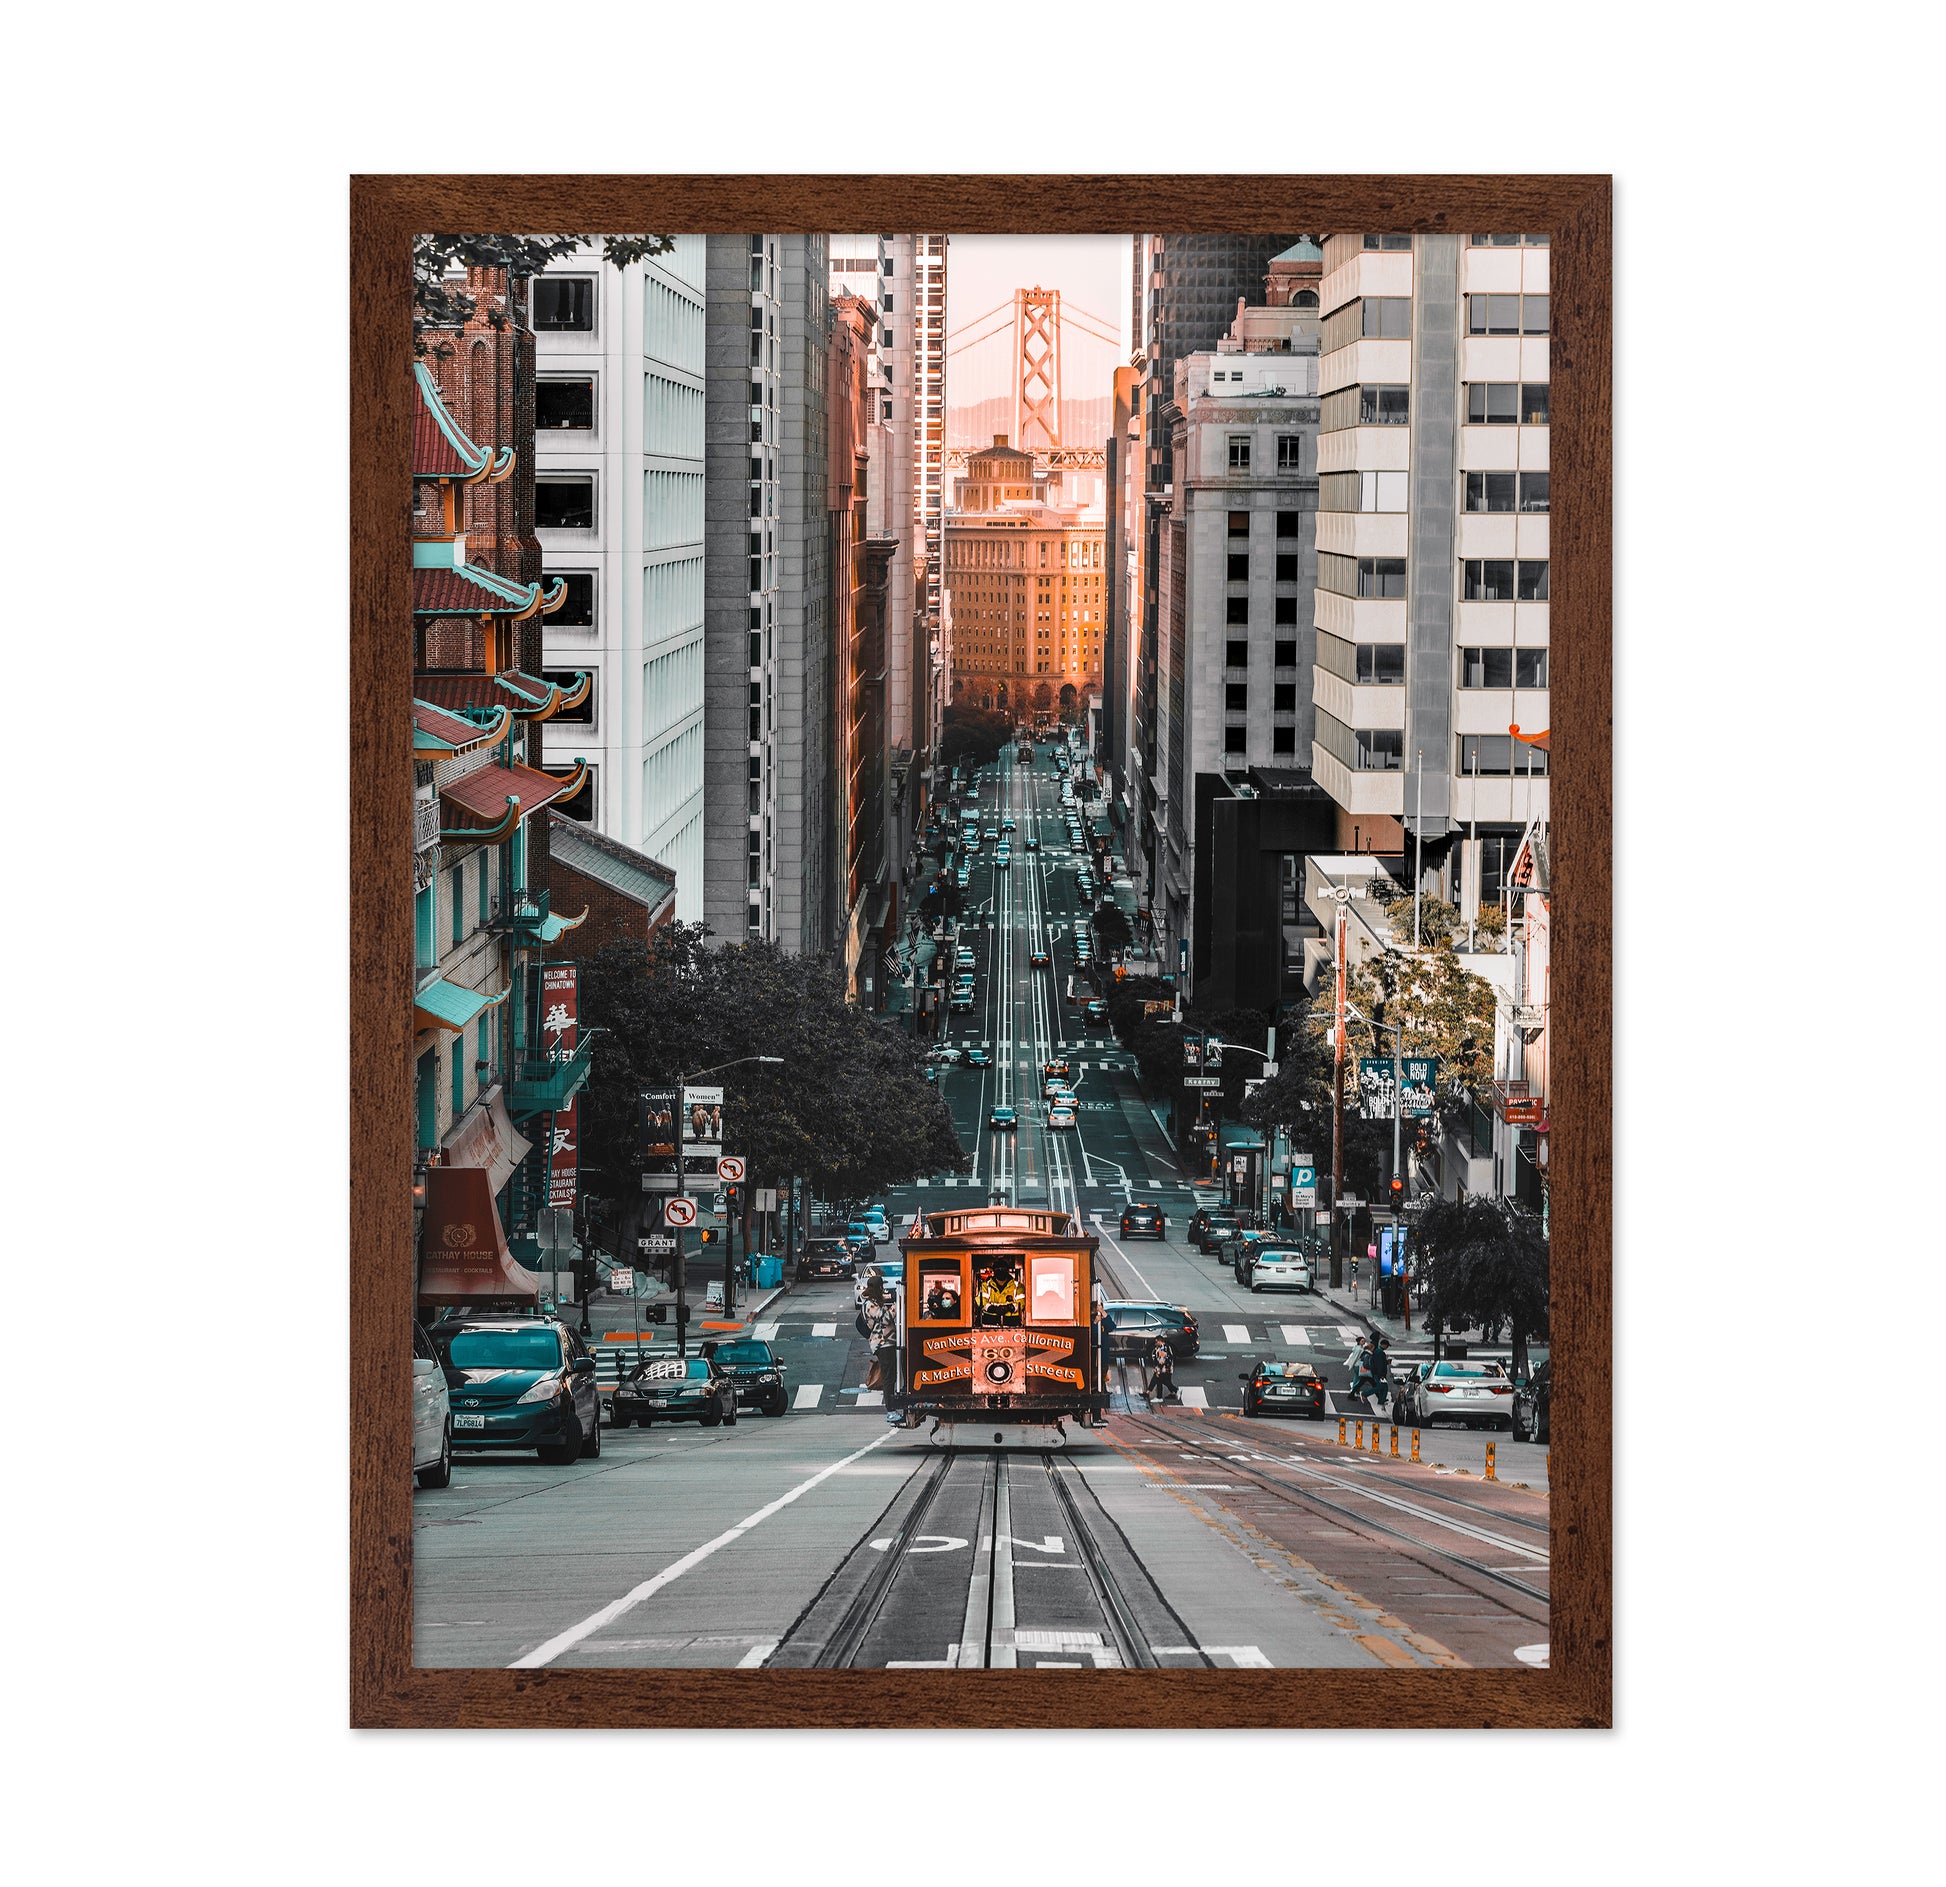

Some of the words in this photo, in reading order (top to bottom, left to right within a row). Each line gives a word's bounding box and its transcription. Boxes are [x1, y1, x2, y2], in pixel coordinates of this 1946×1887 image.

[544, 970, 567, 980] WELCOME
[569, 969, 577, 978] TO
[545, 980, 575, 991] CHINATOWN
[1409, 1063, 1428, 1072] BOLD
[1409, 1071, 1427, 1081] NOW
[562, 1168, 577, 1177] HOUSE
[543, 1178, 577, 1189] STAURANT
[426, 1251, 460, 1260] CATHAY
[463, 1251, 494, 1260] HOUSE
[926, 1340, 947, 1351] Van
[947, 1337, 977, 1348] Ness
[1013, 1333, 1073, 1350] California
[983, 1347, 1014, 1360] 60
[920, 1371, 930, 1382] &
[1025, 1363, 1076, 1379] Streets
